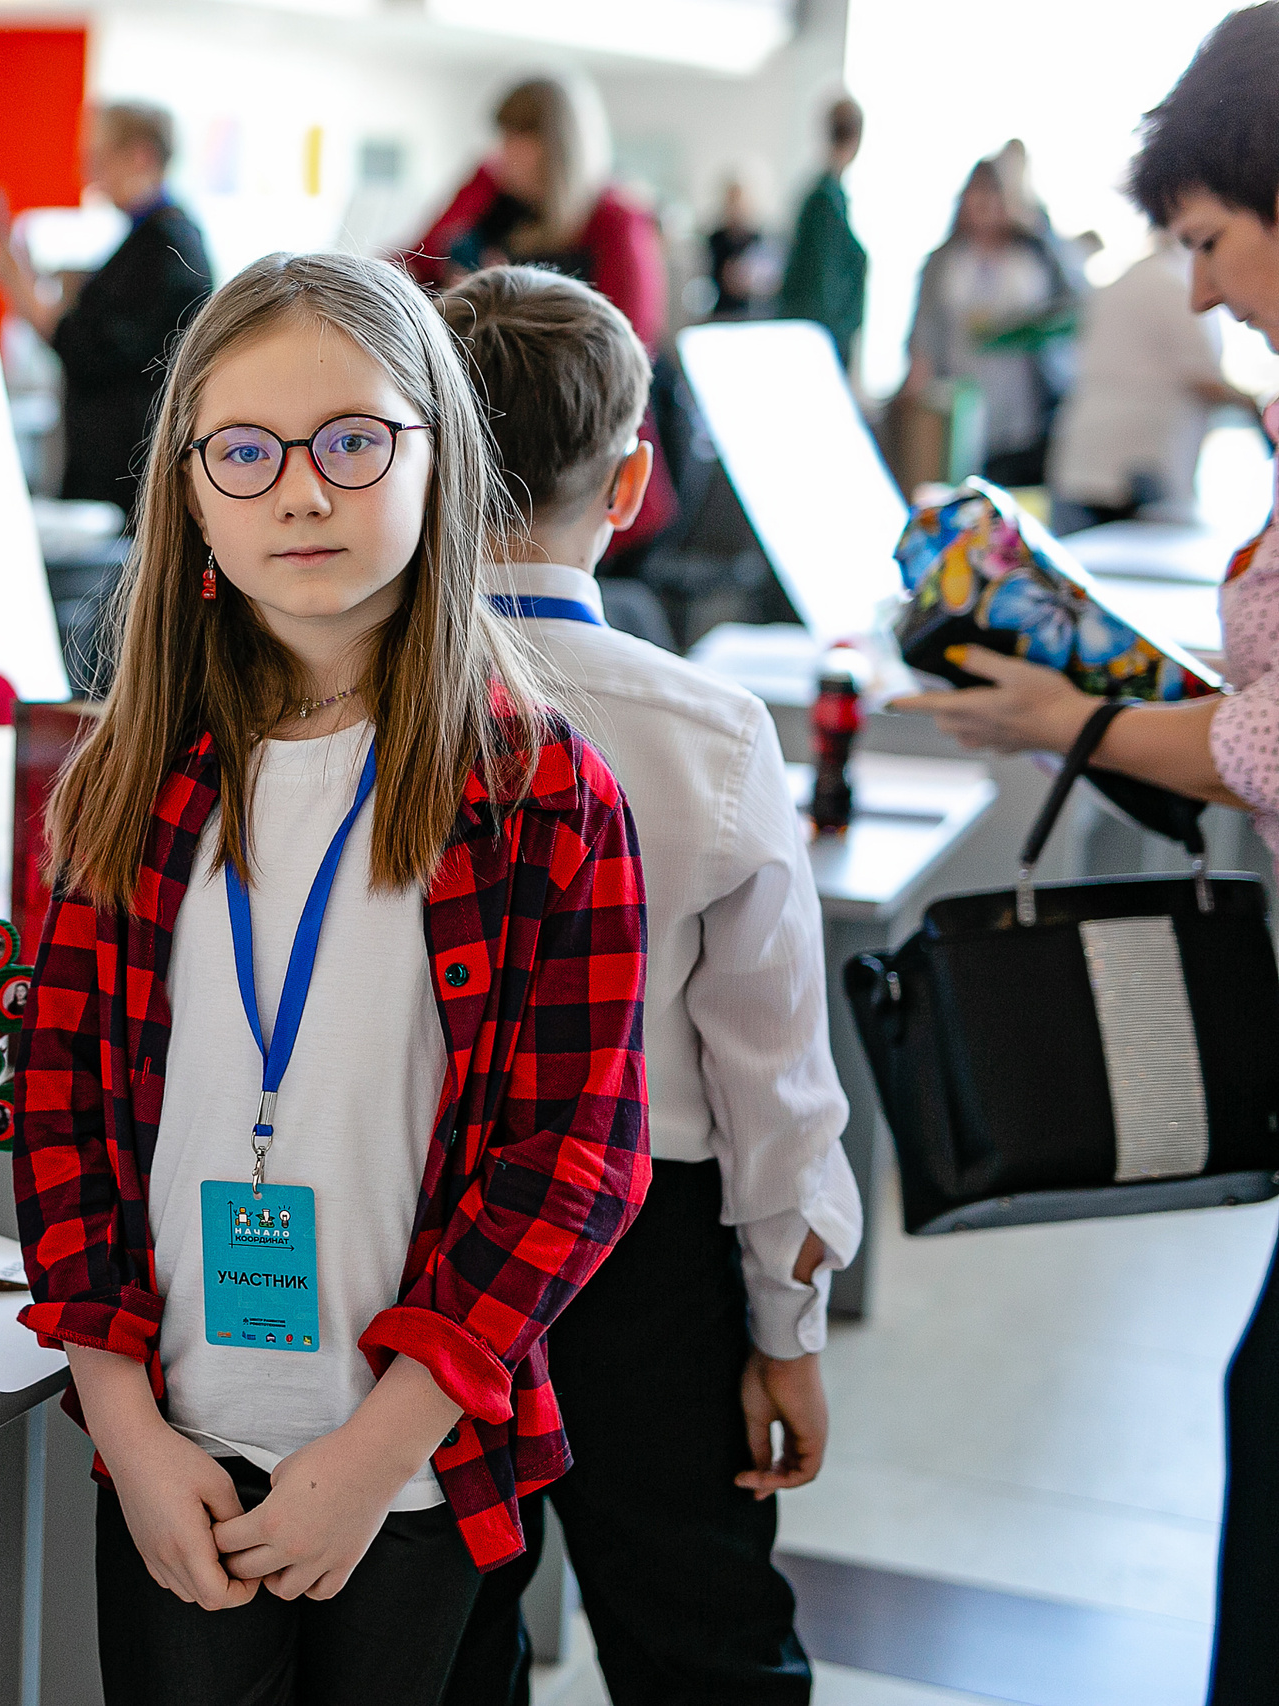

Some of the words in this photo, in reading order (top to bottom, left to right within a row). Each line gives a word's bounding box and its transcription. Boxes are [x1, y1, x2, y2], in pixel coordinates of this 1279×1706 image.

[235, 1227, 290, 1238] НАЧАЛО
[235, 1236, 290, 1245] КООРДИНАТ
[217, 1270, 309, 1290] УЧАСТНИК
